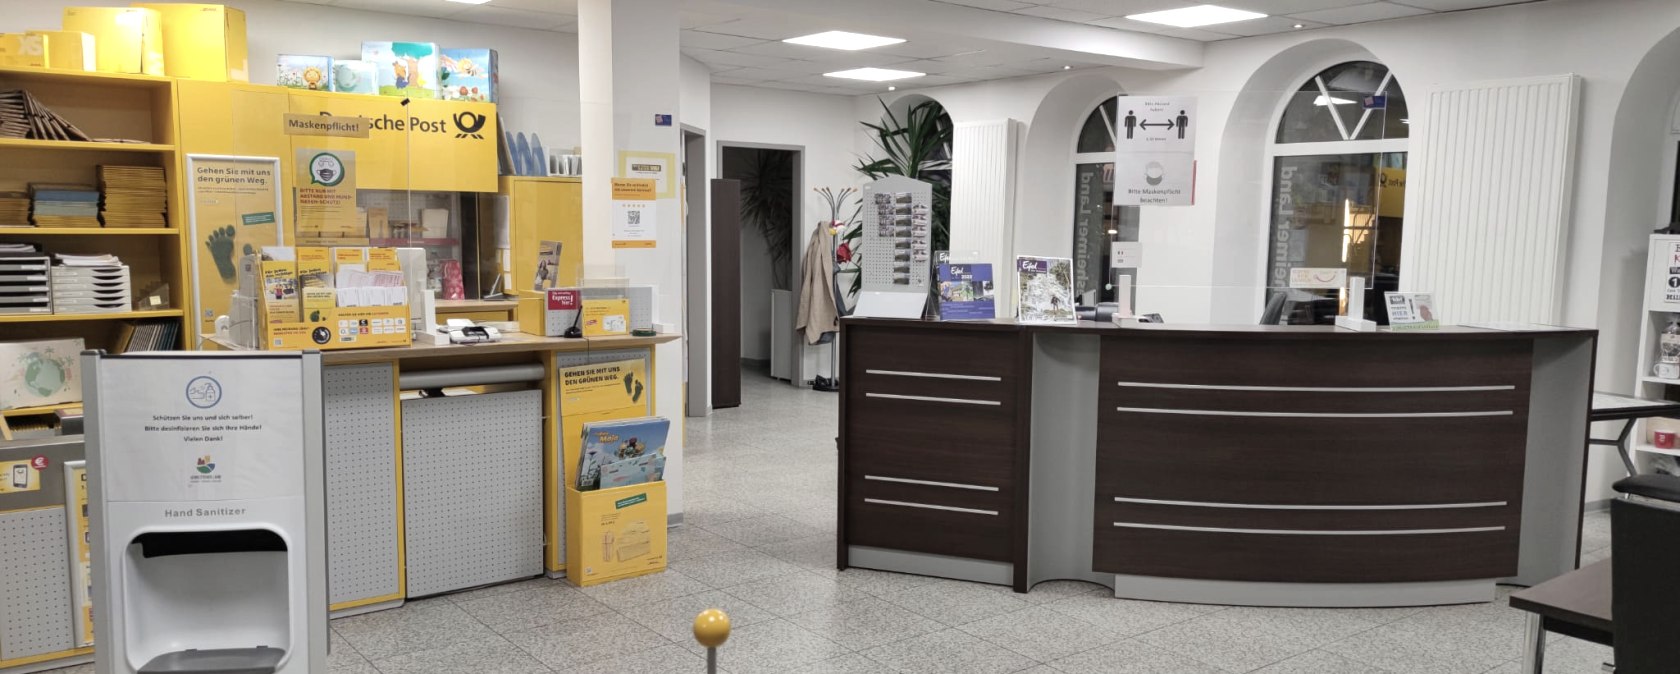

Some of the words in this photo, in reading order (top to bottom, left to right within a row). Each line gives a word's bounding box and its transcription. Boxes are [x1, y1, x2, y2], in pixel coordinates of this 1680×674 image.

[288, 119, 359, 132] Maskenpflicht!
[410, 116, 447, 133] Post
[197, 167, 224, 175] Gehen
[240, 168, 254, 176] mit
[215, 176, 245, 184] grünen
[247, 177, 268, 185] Weg.
[578, 375, 603, 384] GRÜNEN
[165, 509, 193, 517] Hand
[196, 508, 246, 516] Sanitizer
